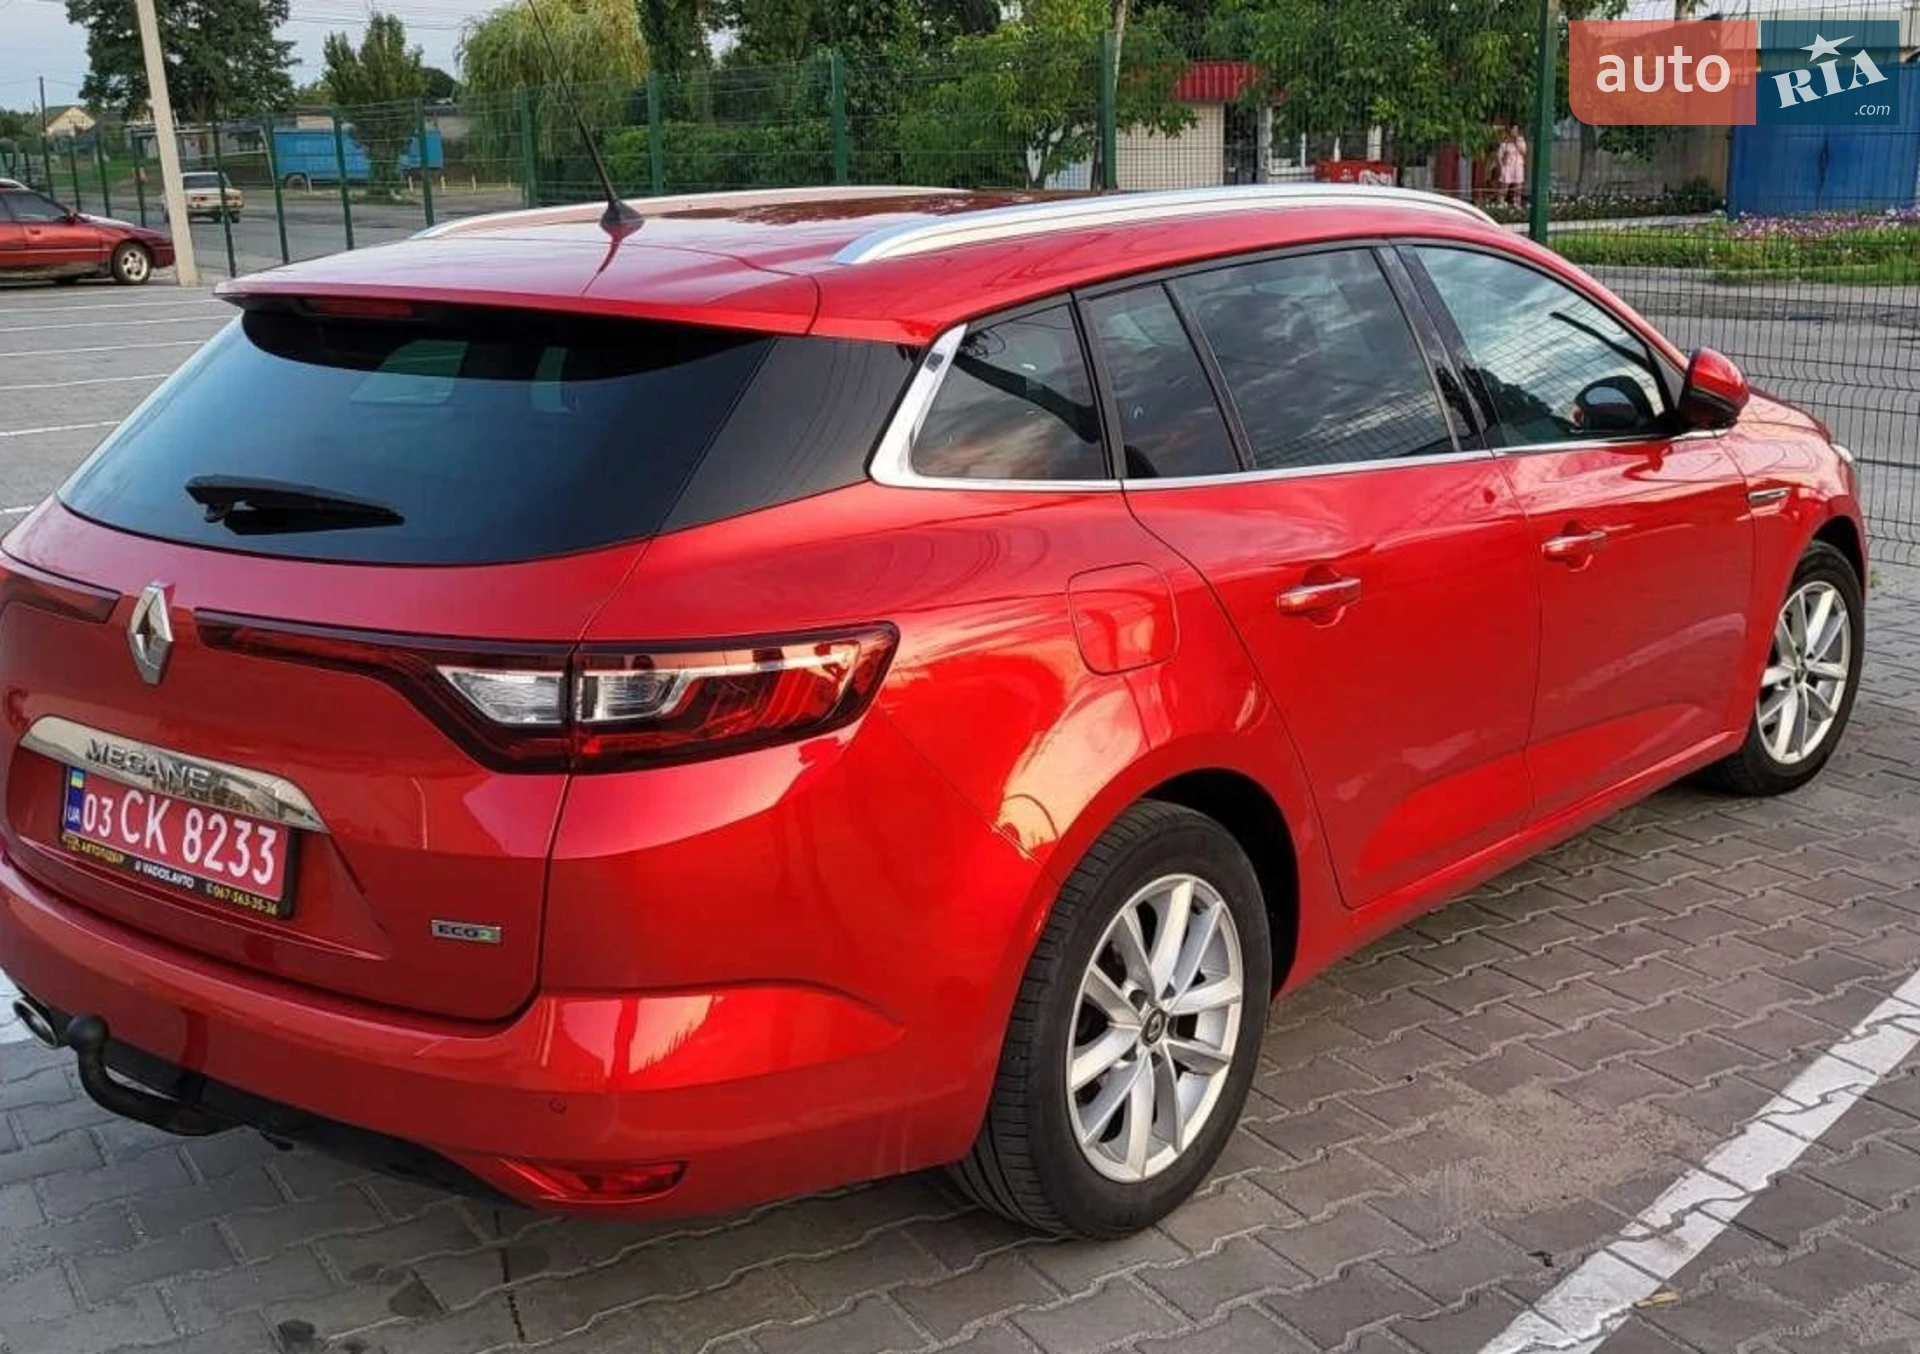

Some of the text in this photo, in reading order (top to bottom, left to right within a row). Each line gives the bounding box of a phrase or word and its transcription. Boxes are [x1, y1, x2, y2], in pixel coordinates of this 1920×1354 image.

[85, 738, 210, 790] MEGANE
[67, 806, 80, 823] UA
[83, 789, 277, 885] 03 CK 8233
